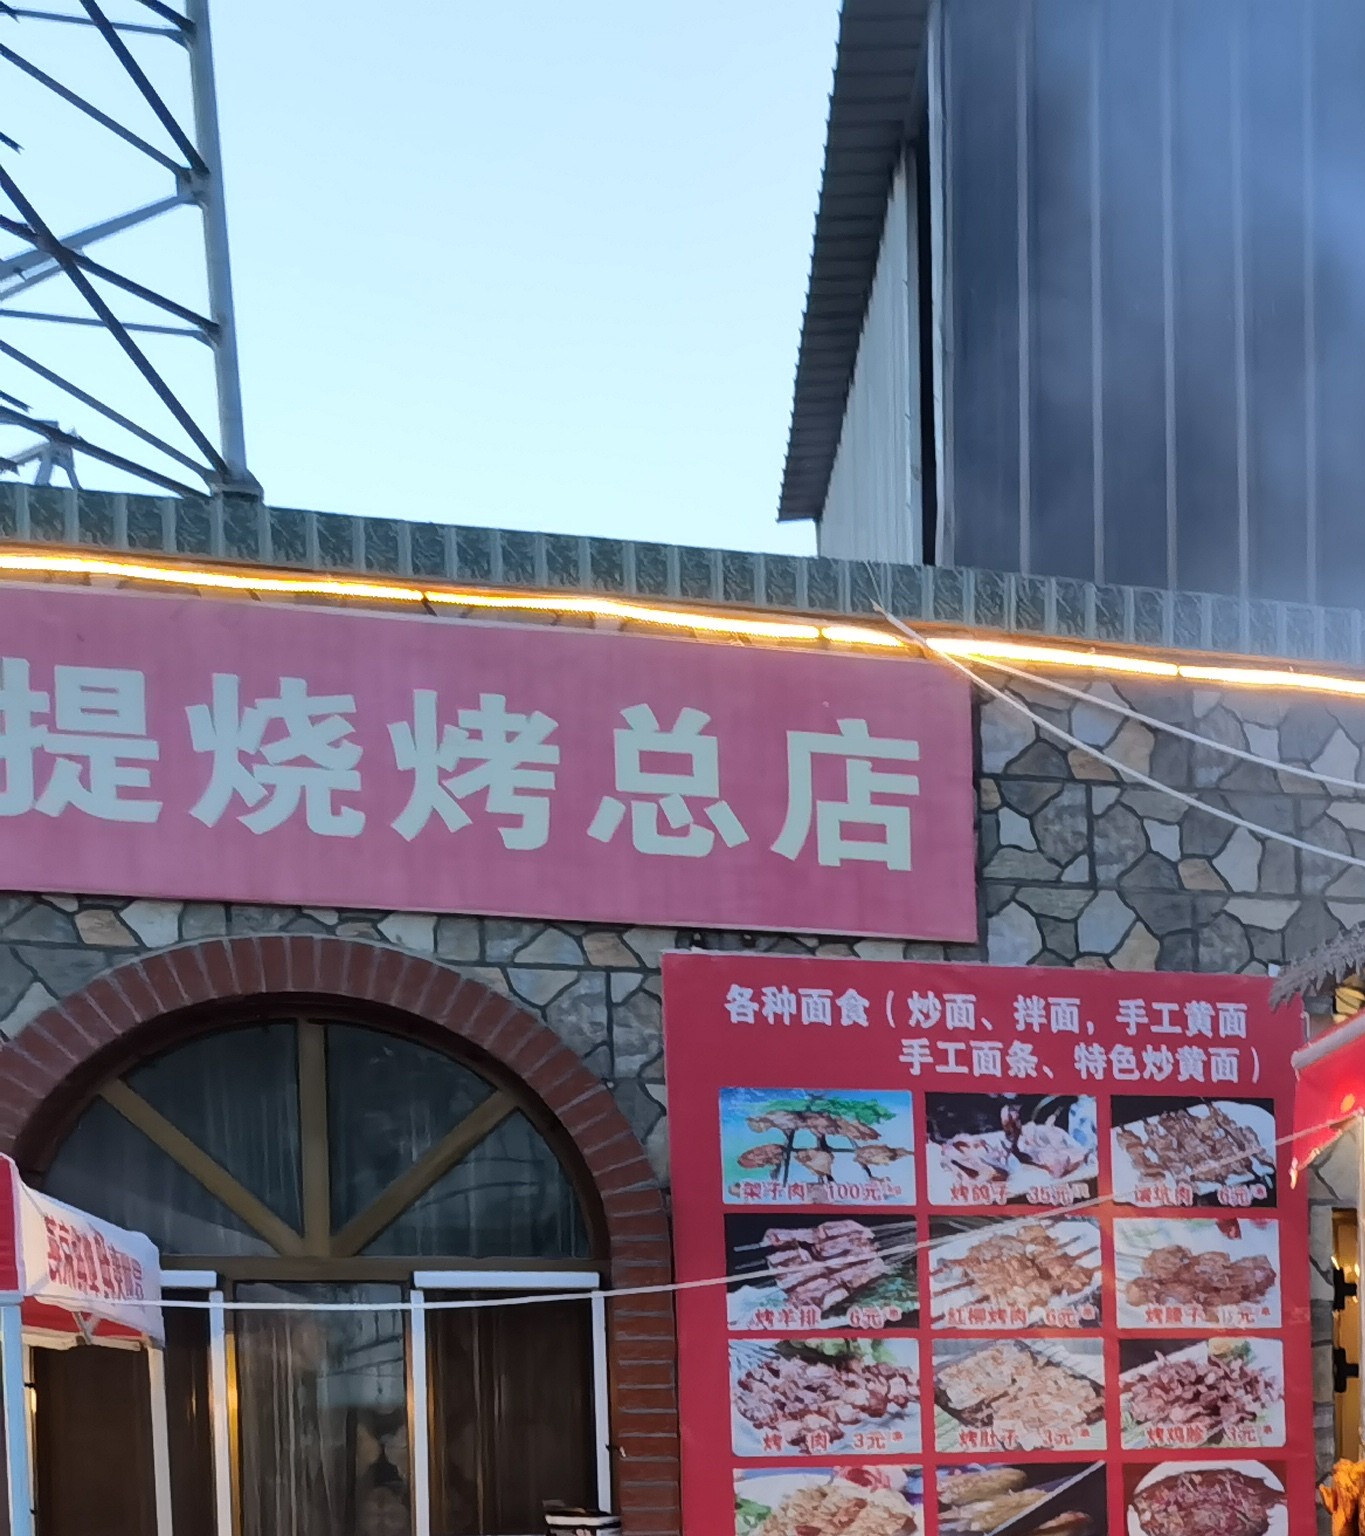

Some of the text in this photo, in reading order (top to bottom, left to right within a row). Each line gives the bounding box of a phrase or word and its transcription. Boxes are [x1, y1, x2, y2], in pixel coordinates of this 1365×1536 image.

[0, 657, 922, 872] 提烧烤总店
